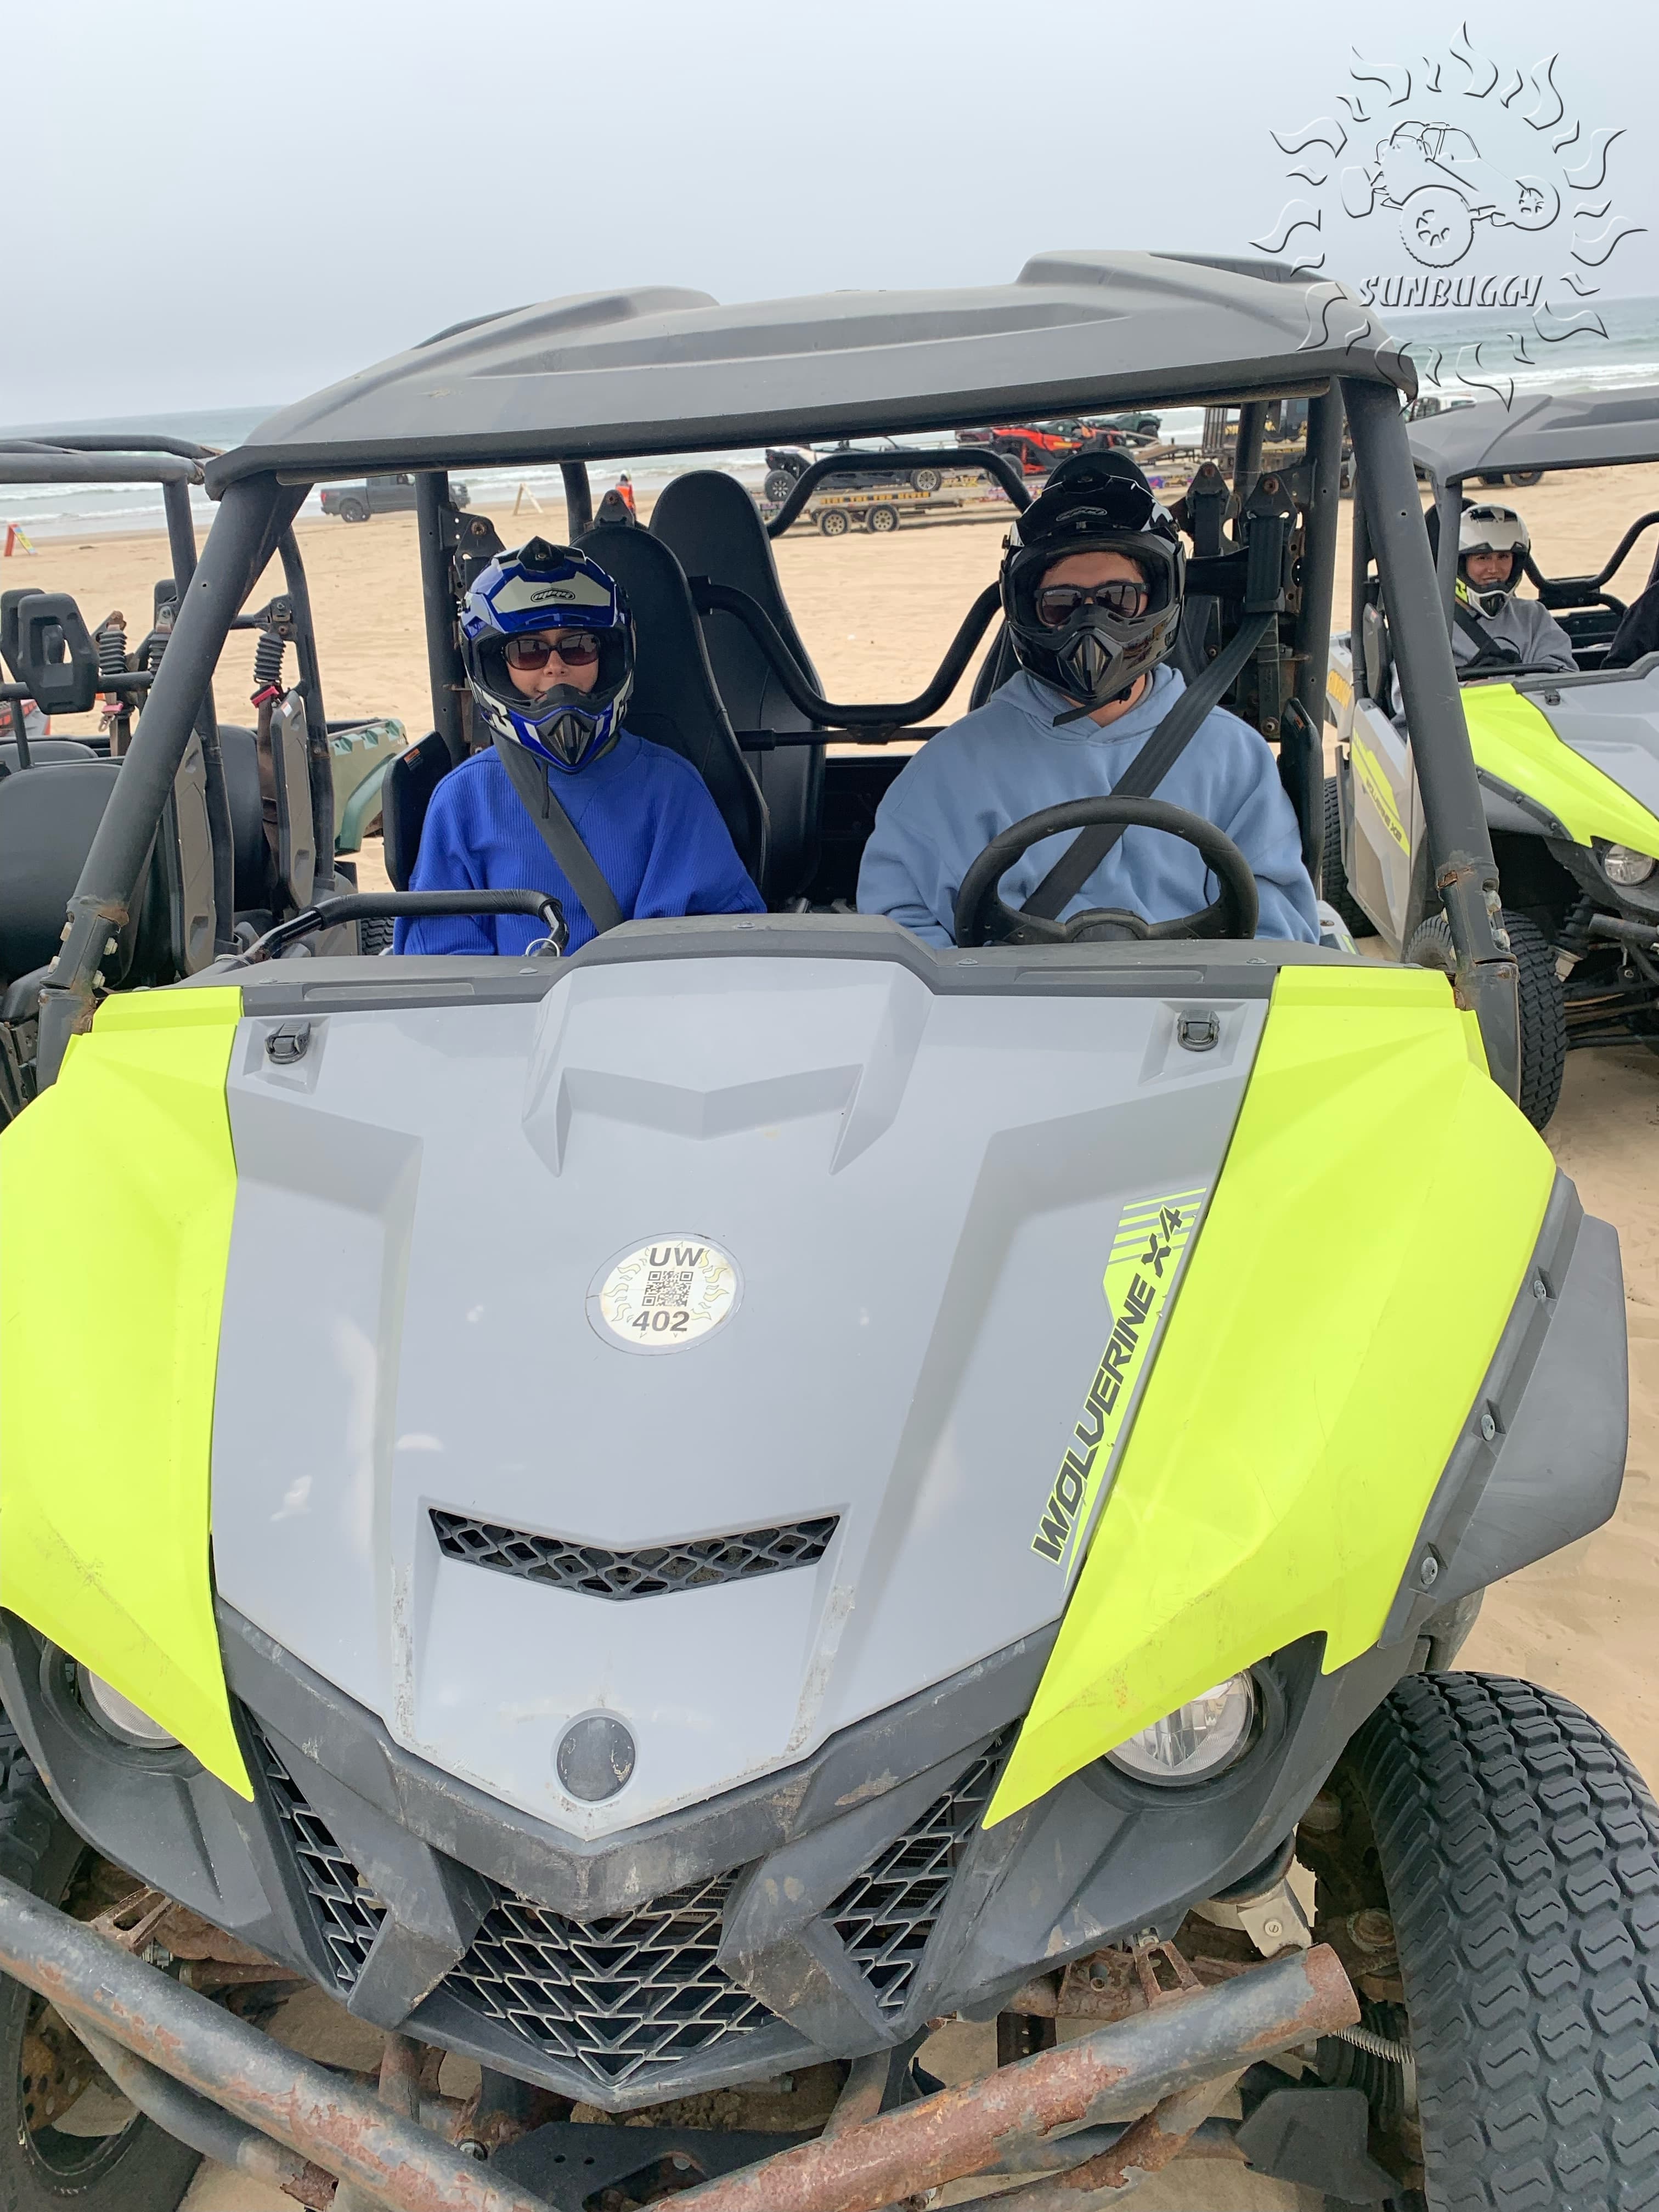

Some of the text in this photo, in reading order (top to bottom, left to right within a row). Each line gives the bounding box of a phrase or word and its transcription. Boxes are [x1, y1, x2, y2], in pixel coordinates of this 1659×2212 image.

[649, 1247, 705, 1267] UW
[632, 1310, 690, 1331] 402
[1032, 1204, 1183, 1564] WOLVERINE X4
